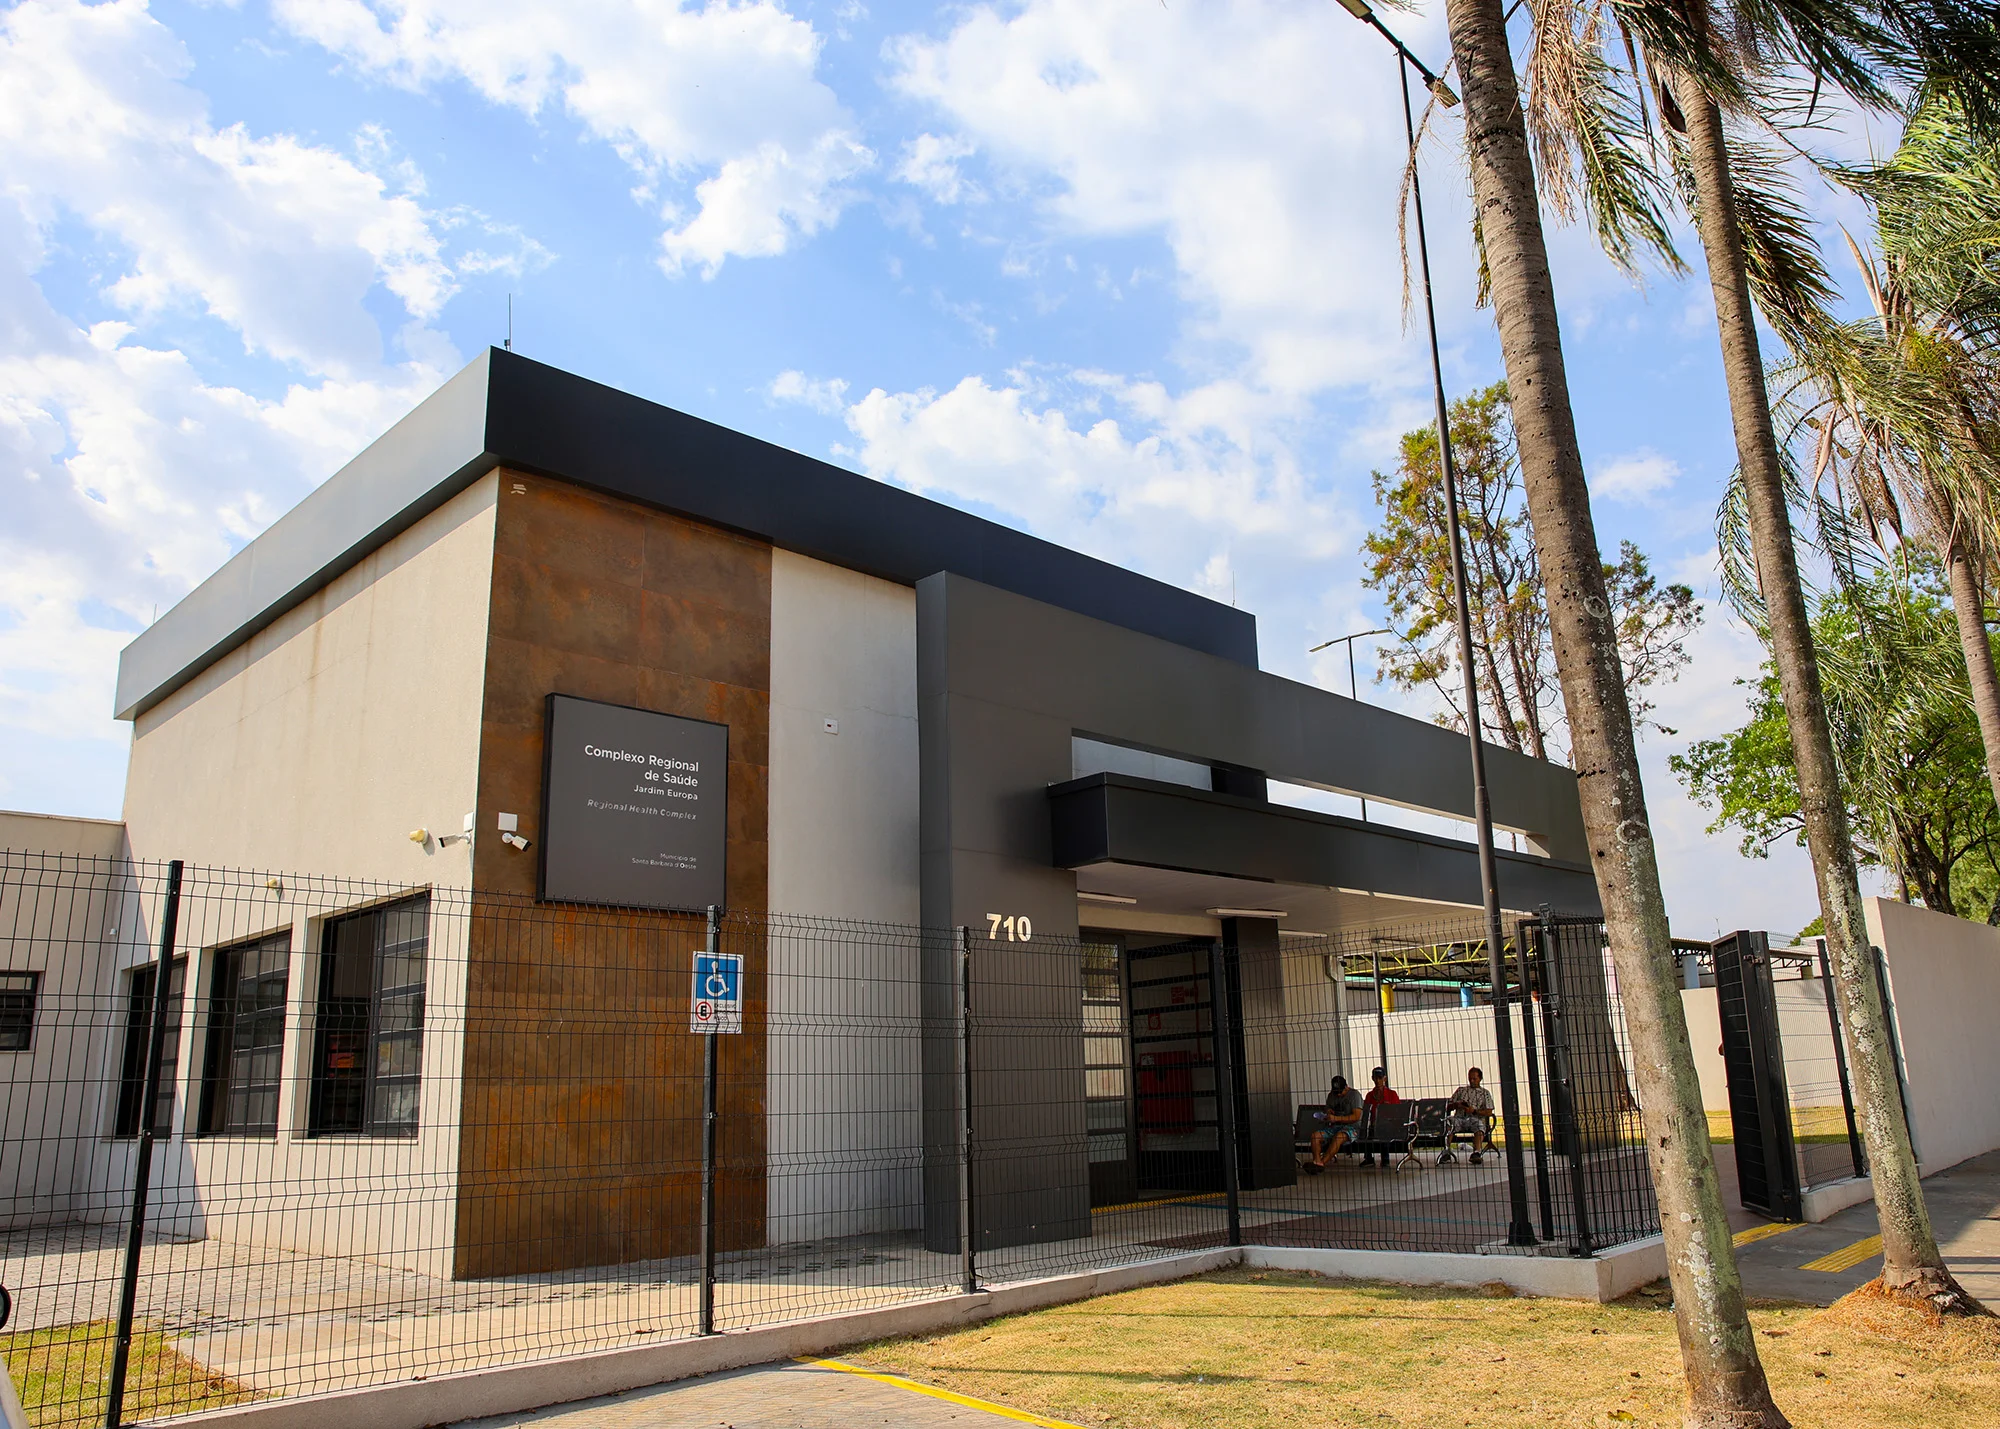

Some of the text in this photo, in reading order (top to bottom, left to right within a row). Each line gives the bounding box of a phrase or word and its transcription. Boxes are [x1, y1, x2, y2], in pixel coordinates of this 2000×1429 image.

[585, 745, 699, 772] Complexo Regional
[644, 770, 698, 787] de Saúde
[633, 784, 698, 800] Jardim Europa
[587, 799, 697, 820] Regional Health Complex
[987, 913, 1031, 941] 710
[700, 1005, 707, 1018] E
